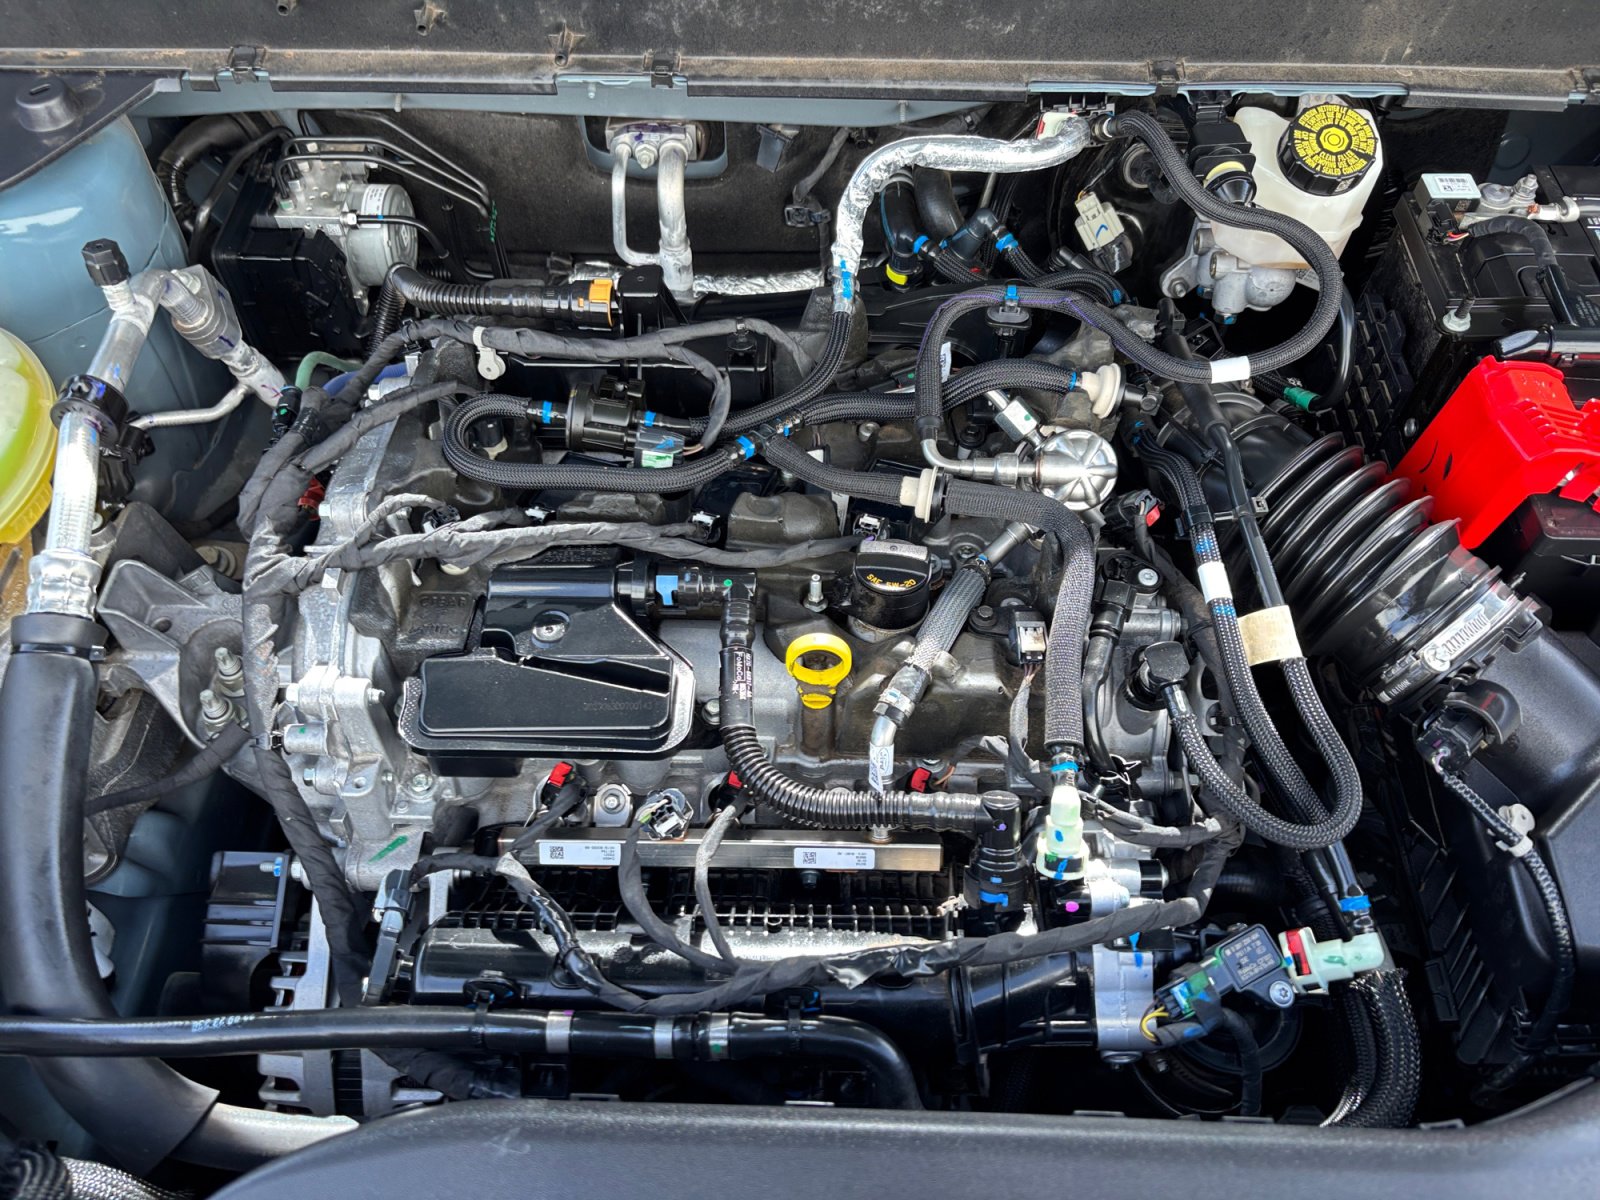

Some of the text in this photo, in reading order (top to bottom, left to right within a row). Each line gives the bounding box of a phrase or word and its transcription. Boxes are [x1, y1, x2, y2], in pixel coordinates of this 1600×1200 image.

[867, 574, 917, 588] SAE 5W-20
[735, 652, 744, 681] FoMoCo
